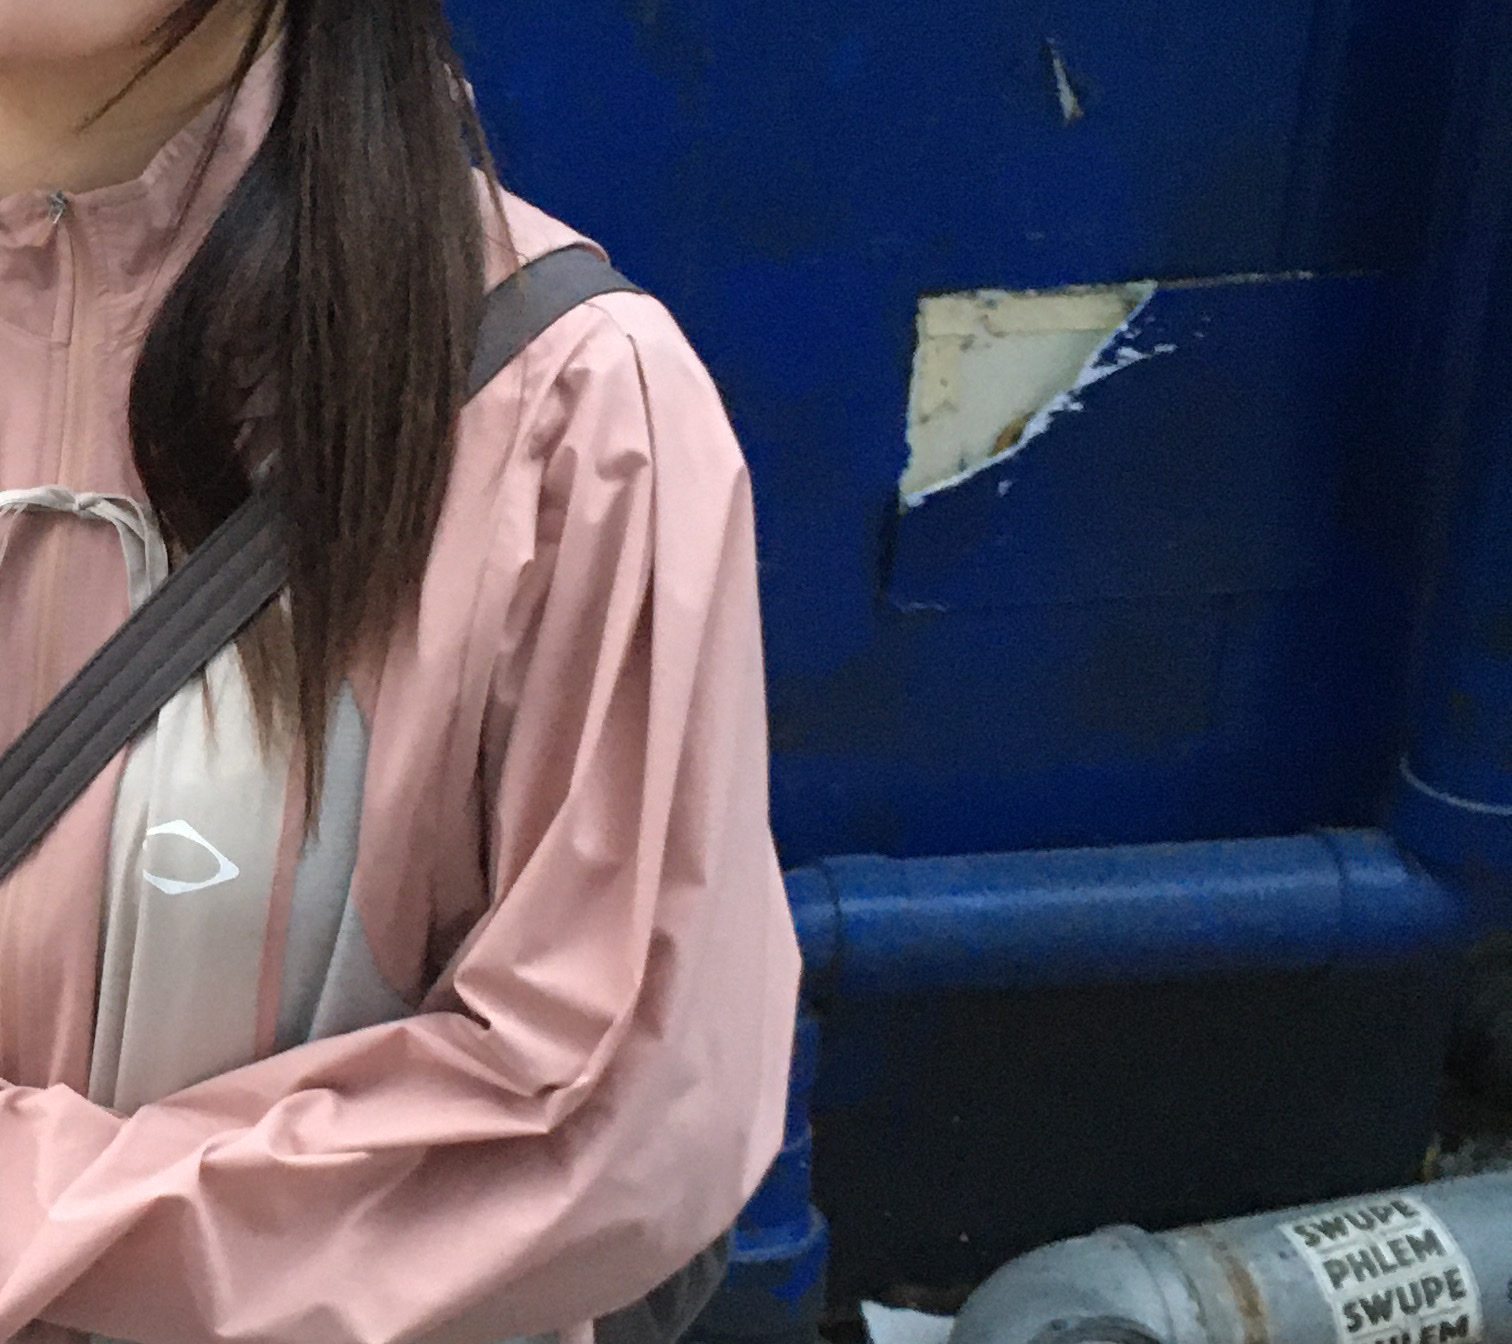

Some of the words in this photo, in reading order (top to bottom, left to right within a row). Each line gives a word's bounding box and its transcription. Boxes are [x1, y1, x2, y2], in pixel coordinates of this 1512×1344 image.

[1294, 1200, 1419, 1247] SWUPE
[1323, 1229, 1447, 1290] PHLEM
[1343, 1267, 1468, 1333] SWUPE
